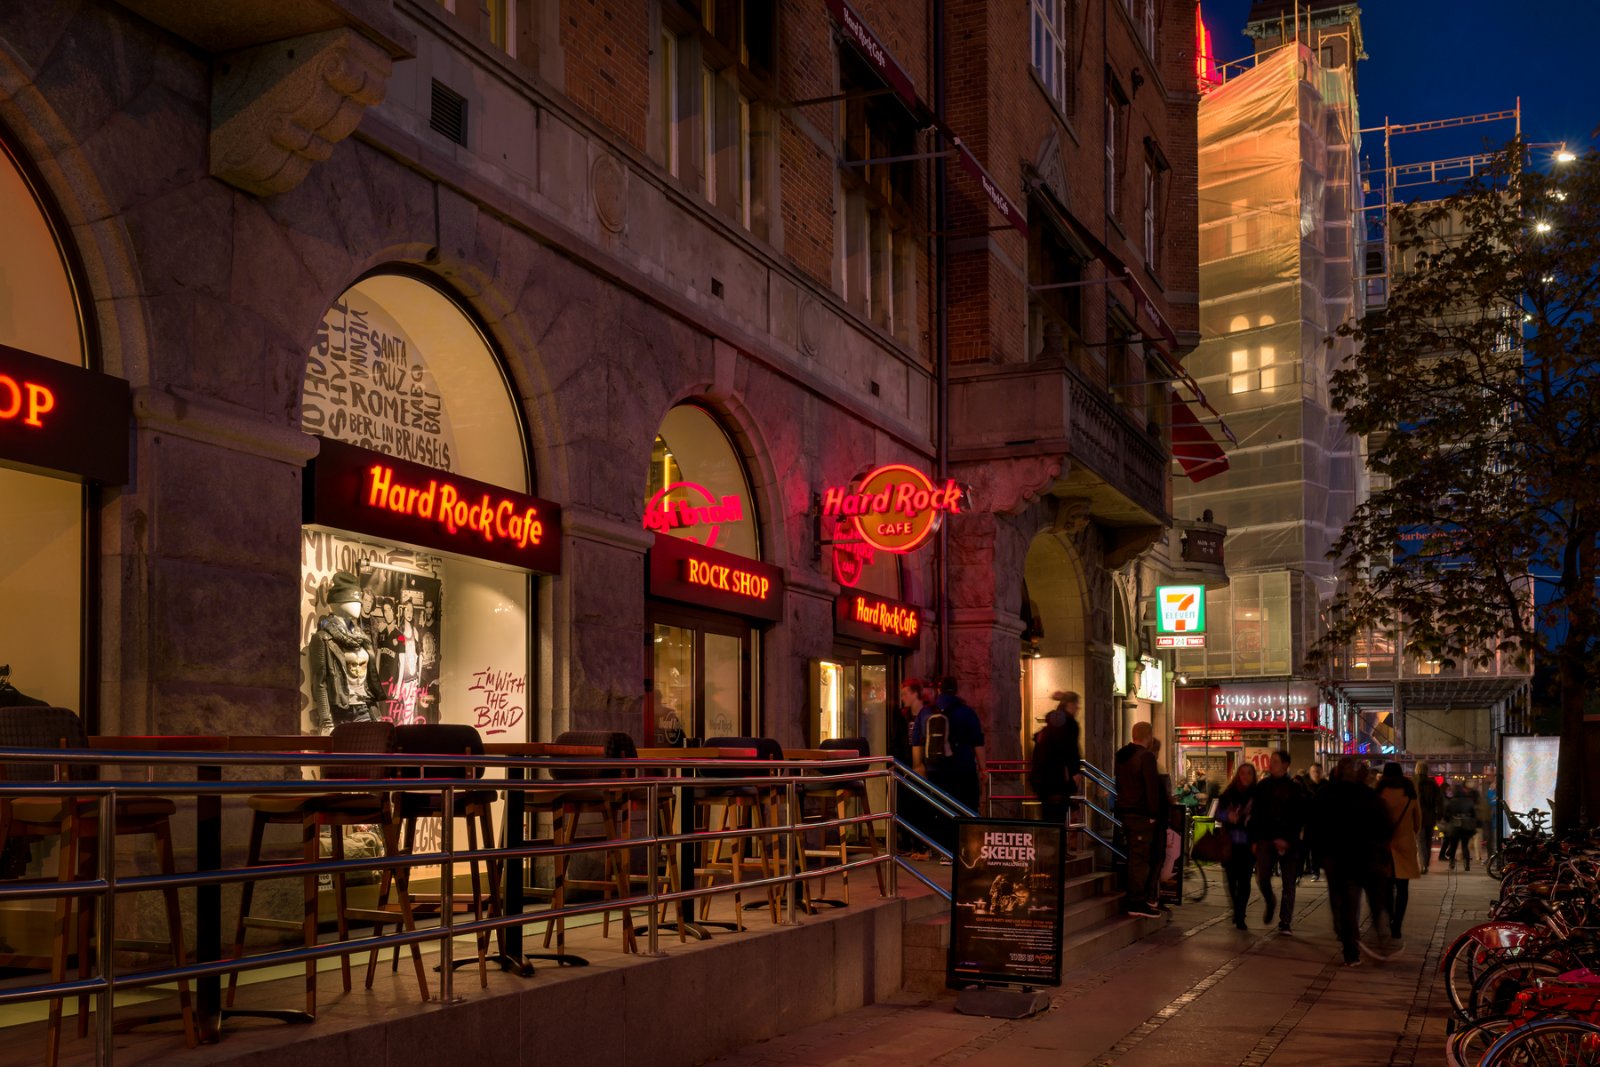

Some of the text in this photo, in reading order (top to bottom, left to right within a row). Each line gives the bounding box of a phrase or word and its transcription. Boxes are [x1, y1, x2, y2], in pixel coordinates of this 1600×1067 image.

[843, 7, 886, 68] Hard Rock Cafe
[349, 310, 369, 379] VIENNA
[370, 330, 407, 368] SANTA
[372, 359, 408, 396] CRUZ
[349, 380, 410, 427] ROME
[423, 391, 441, 435] BALI
[349, 412, 394, 444] BERLIN
[395, 428, 451, 471] BRUSSELS
[369, 465, 543, 549] Hard Rock Cafe
[823, 479, 962, 517] Hard Rock
[877, 522, 913, 535] CAFE
[688, 558, 769, 599] ROCK SHOP
[856, 597, 917, 637] Hard Rock Cafe
[1167, 593, 1194, 630] 7
[1175, 638, 1185, 646] 24
[468, 666, 495, 691] I'M
[385, 699, 413, 719] THE
[474, 706, 524, 728] BAND
[484, 690, 509, 709] THE
[1215, 694, 1255, 706] HOME
[1215, 708, 1307, 722] WHOPPER
[980, 846, 1035, 860] SKELTER
[984, 832, 1032, 846] HELTER
